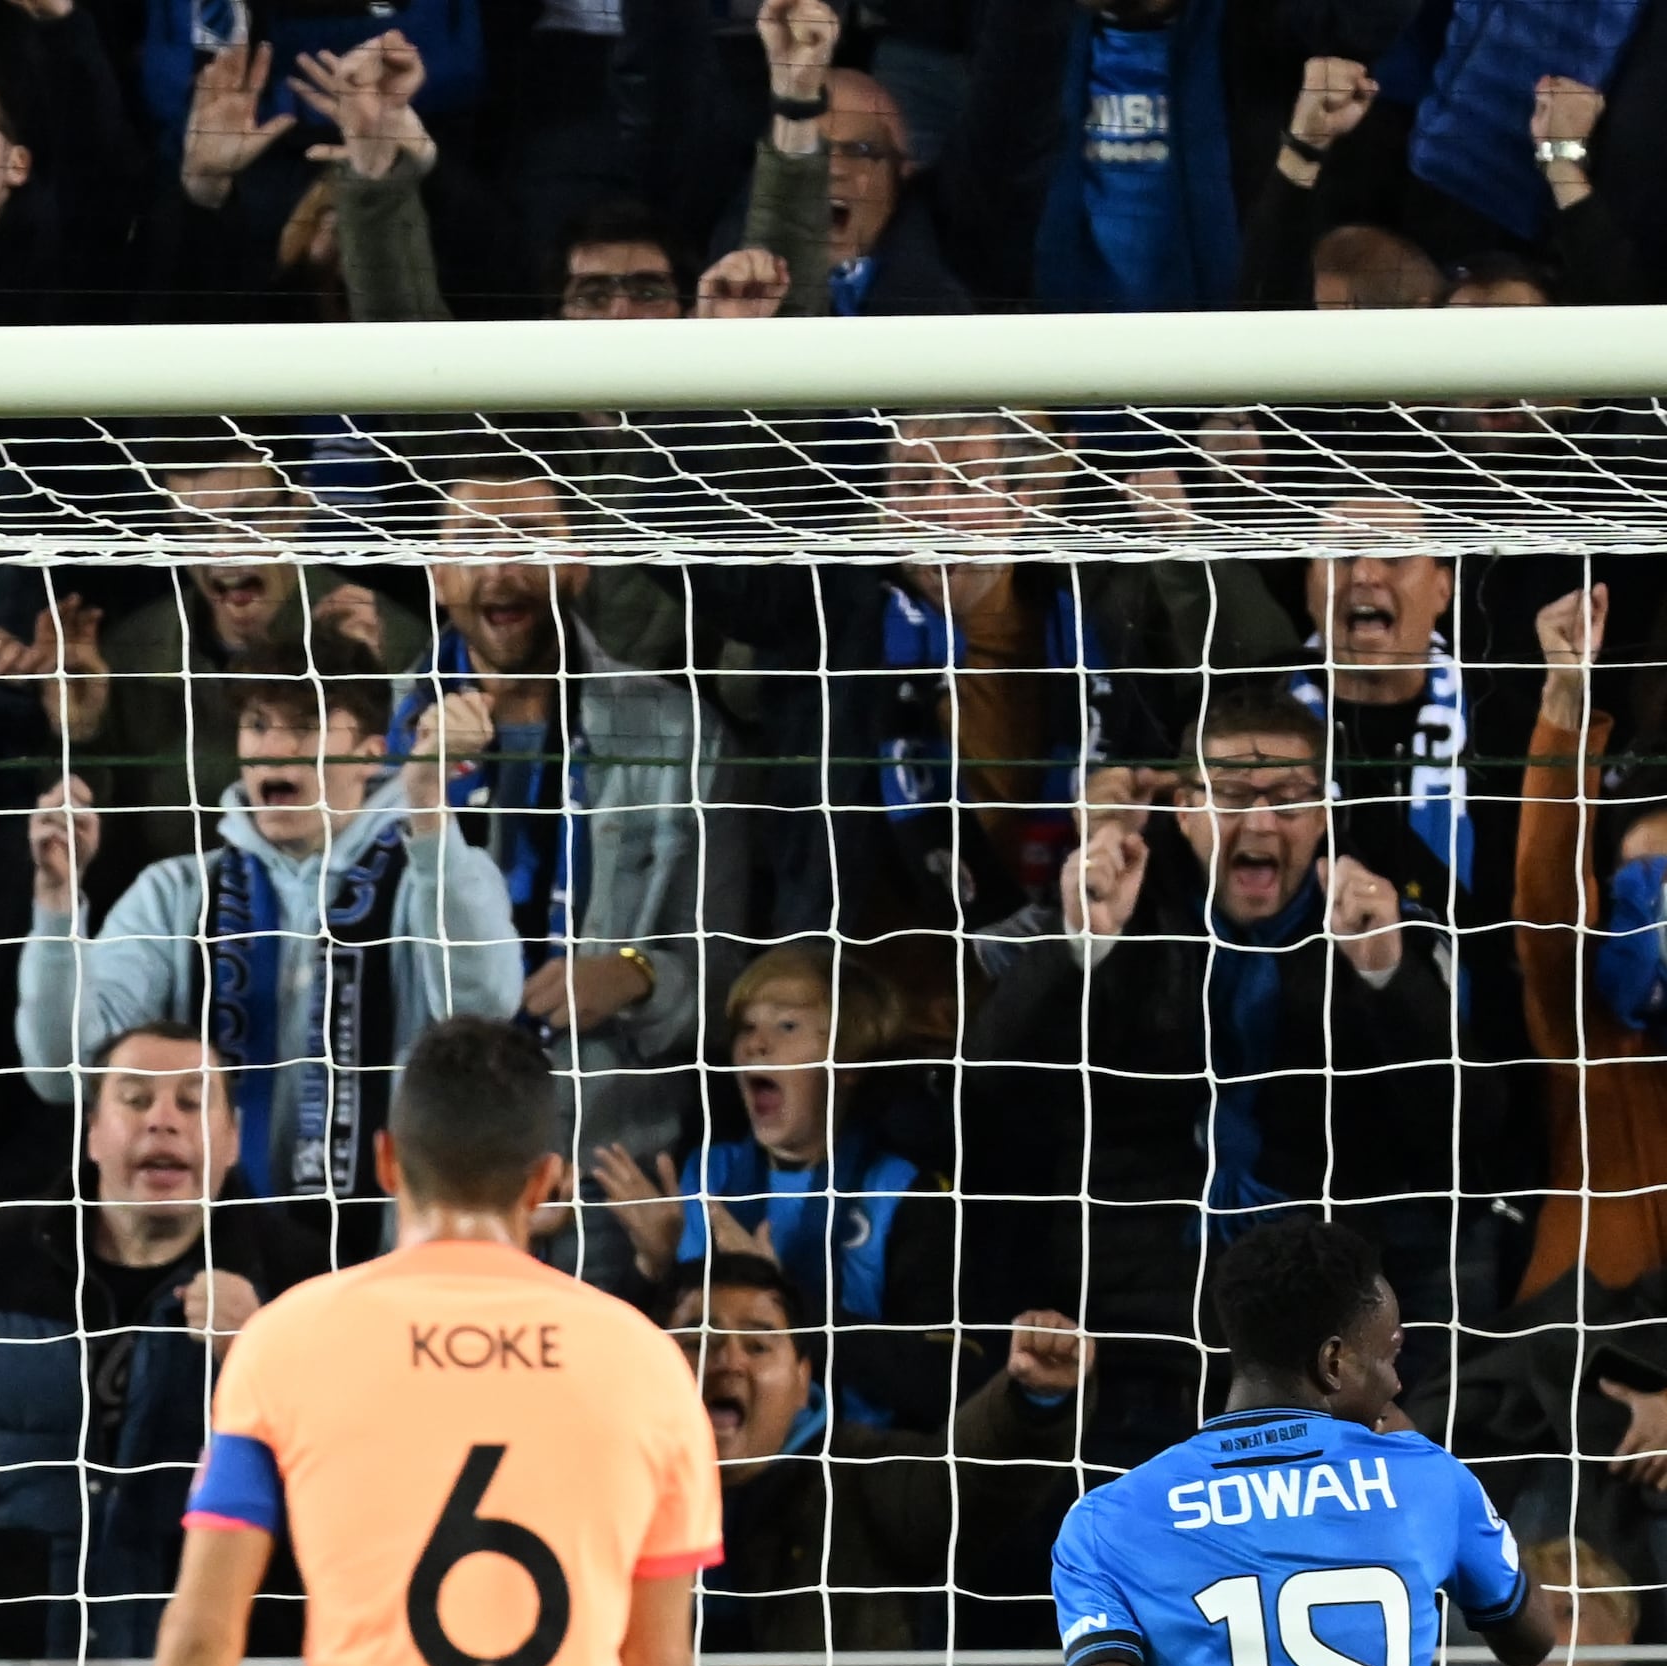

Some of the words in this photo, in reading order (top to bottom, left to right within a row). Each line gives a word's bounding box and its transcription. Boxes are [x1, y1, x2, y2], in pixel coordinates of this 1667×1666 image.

[409, 1324, 565, 1370] KOKE
[1234, 1434, 1263, 1451] SWEAT
[1264, 1429, 1279, 1445] NO
[1280, 1422, 1309, 1442] GLORY
[1167, 1457, 1398, 1530] SOWAH
